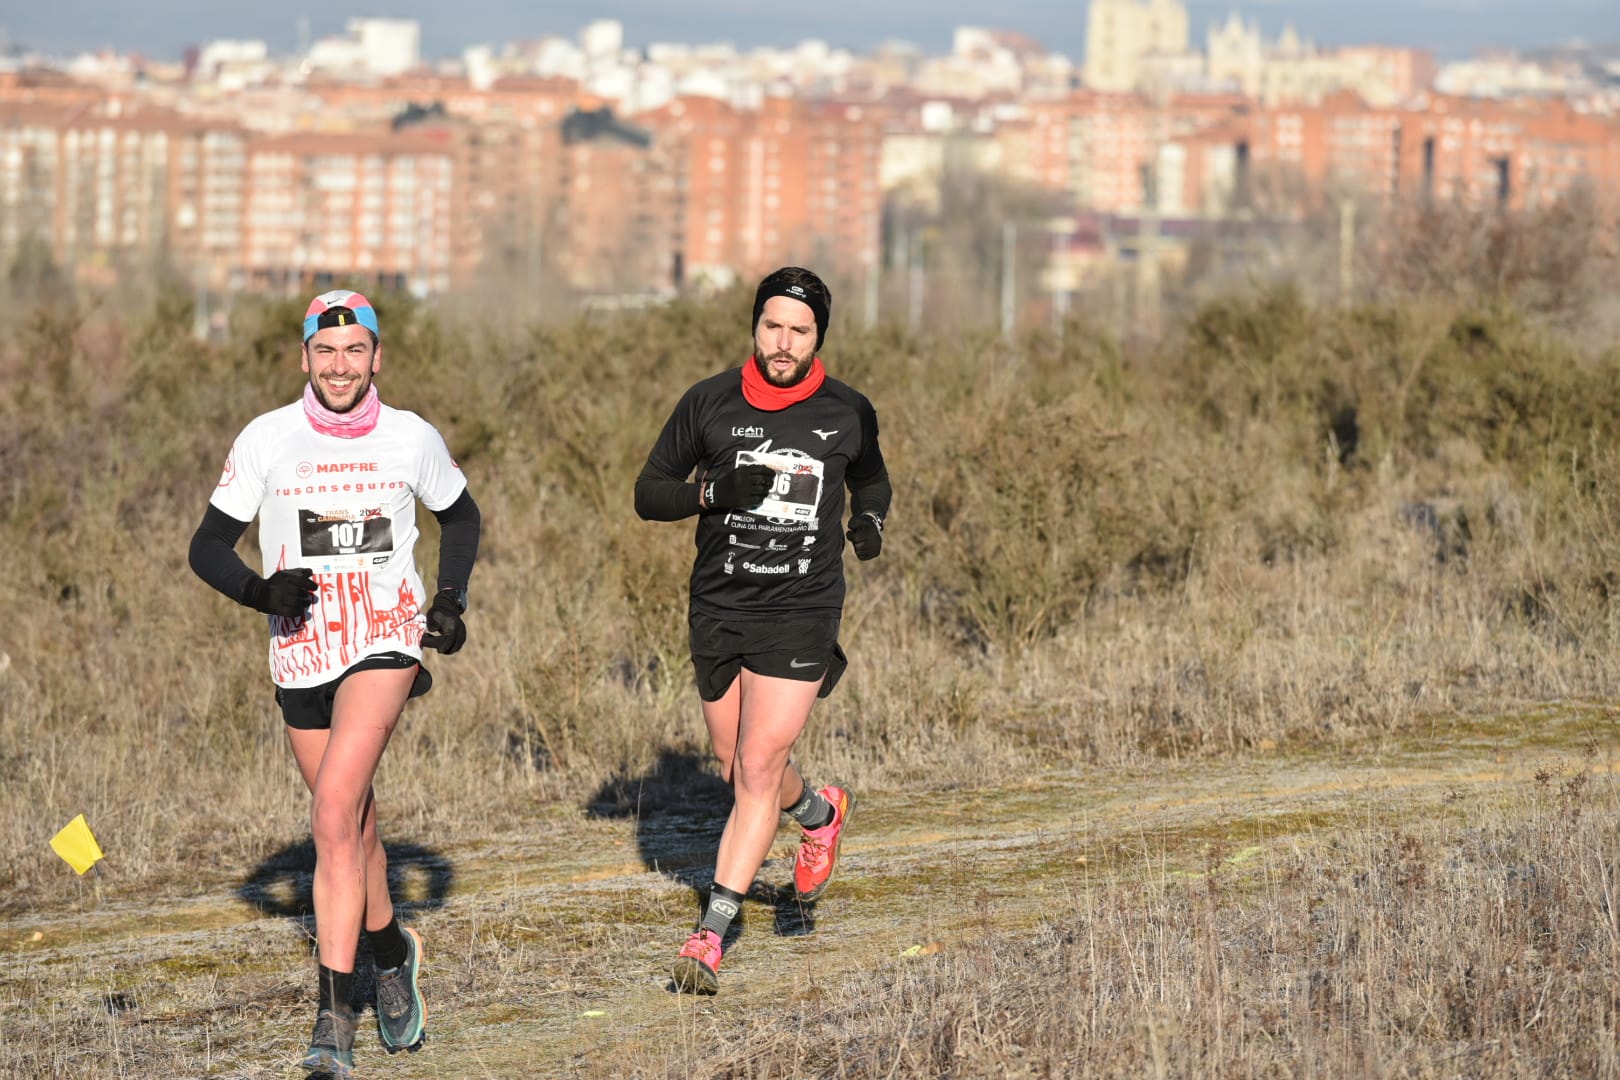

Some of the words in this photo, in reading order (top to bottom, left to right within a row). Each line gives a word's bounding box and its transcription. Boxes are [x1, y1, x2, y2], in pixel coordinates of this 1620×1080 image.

[316, 462, 379, 473] MAPFRE
[275, 481, 404, 497] rusanseguros
[359, 507, 382, 517] 2022
[730, 522, 747, 530] CUNA
[327, 521, 364, 547] 107
[748, 562, 790, 574] Sabadell
